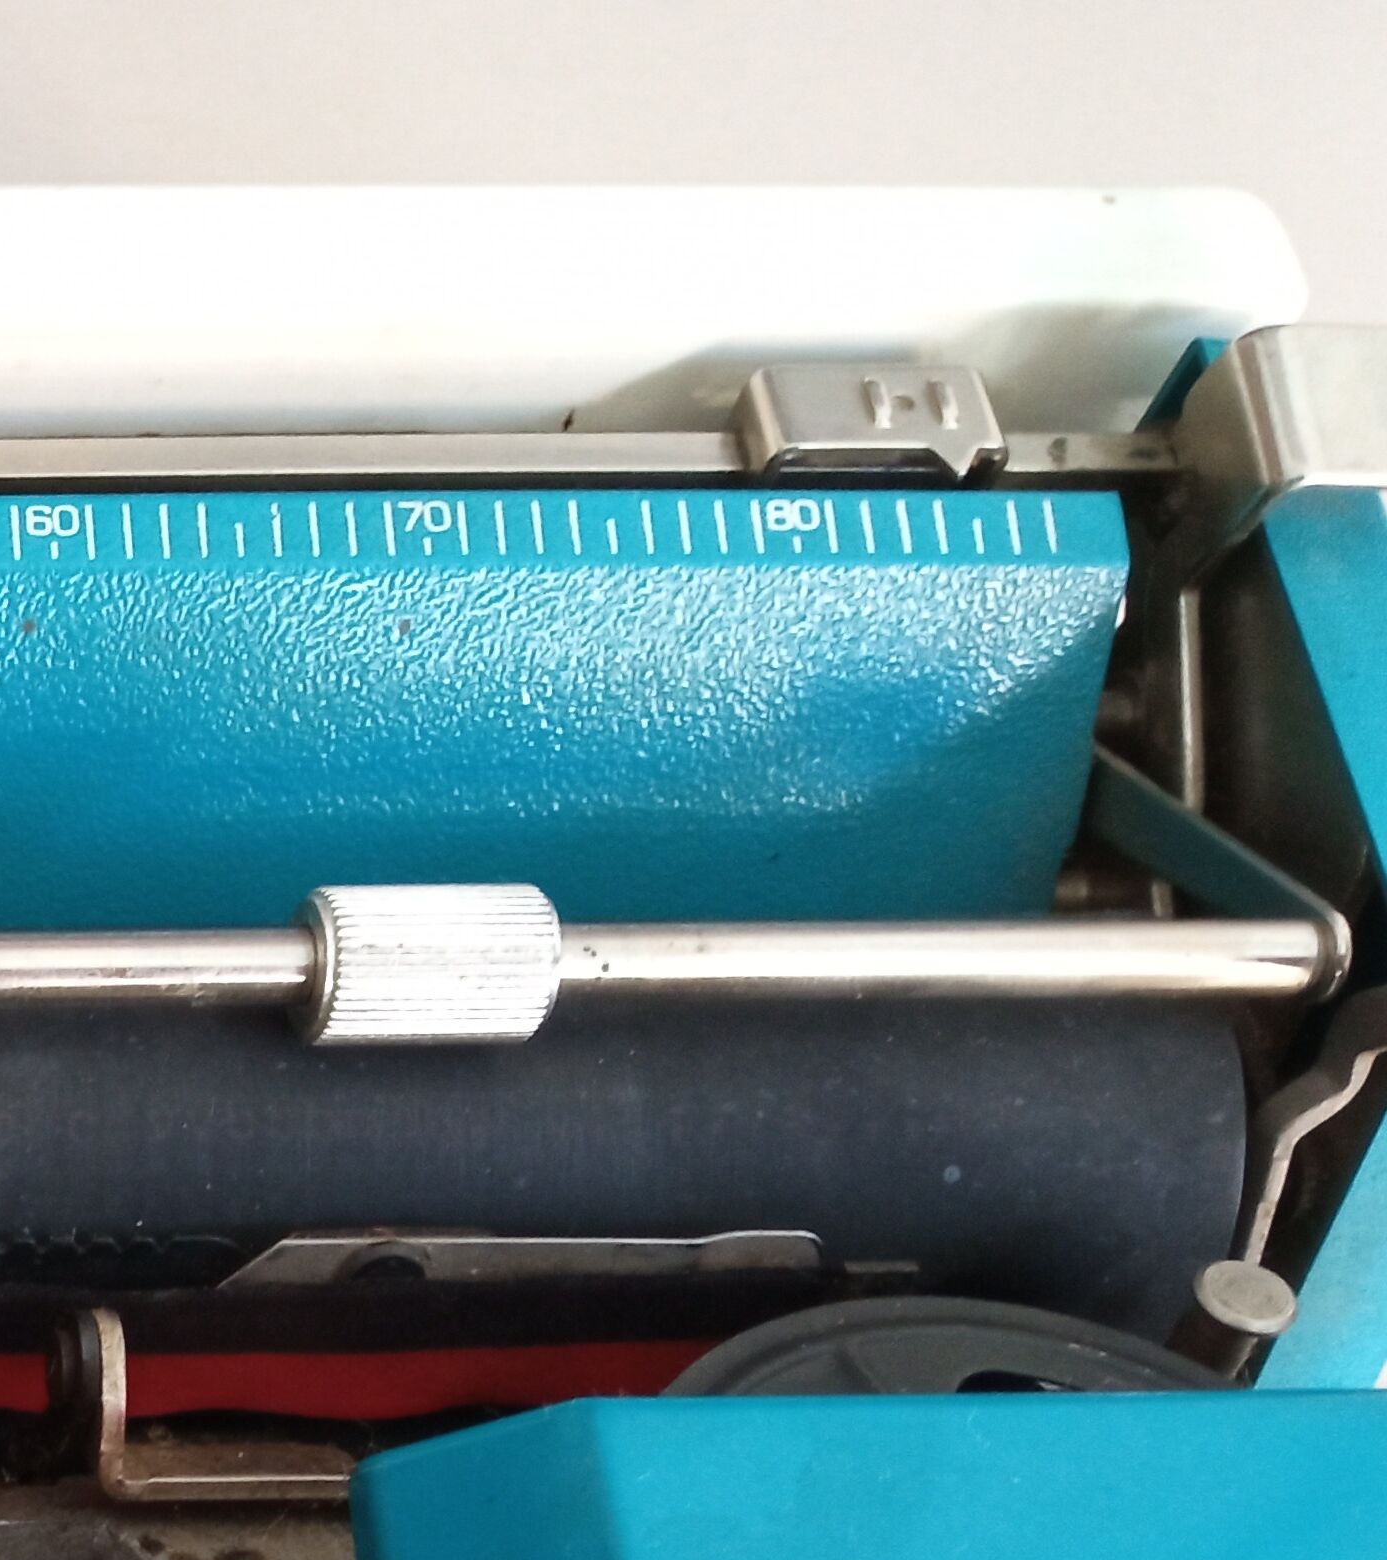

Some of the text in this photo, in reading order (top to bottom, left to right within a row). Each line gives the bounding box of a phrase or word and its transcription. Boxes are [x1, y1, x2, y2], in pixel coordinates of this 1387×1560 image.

[24, 505, 81, 537] 60
[397, 499, 453, 533] 70
[764, 499, 821, 532] 80
